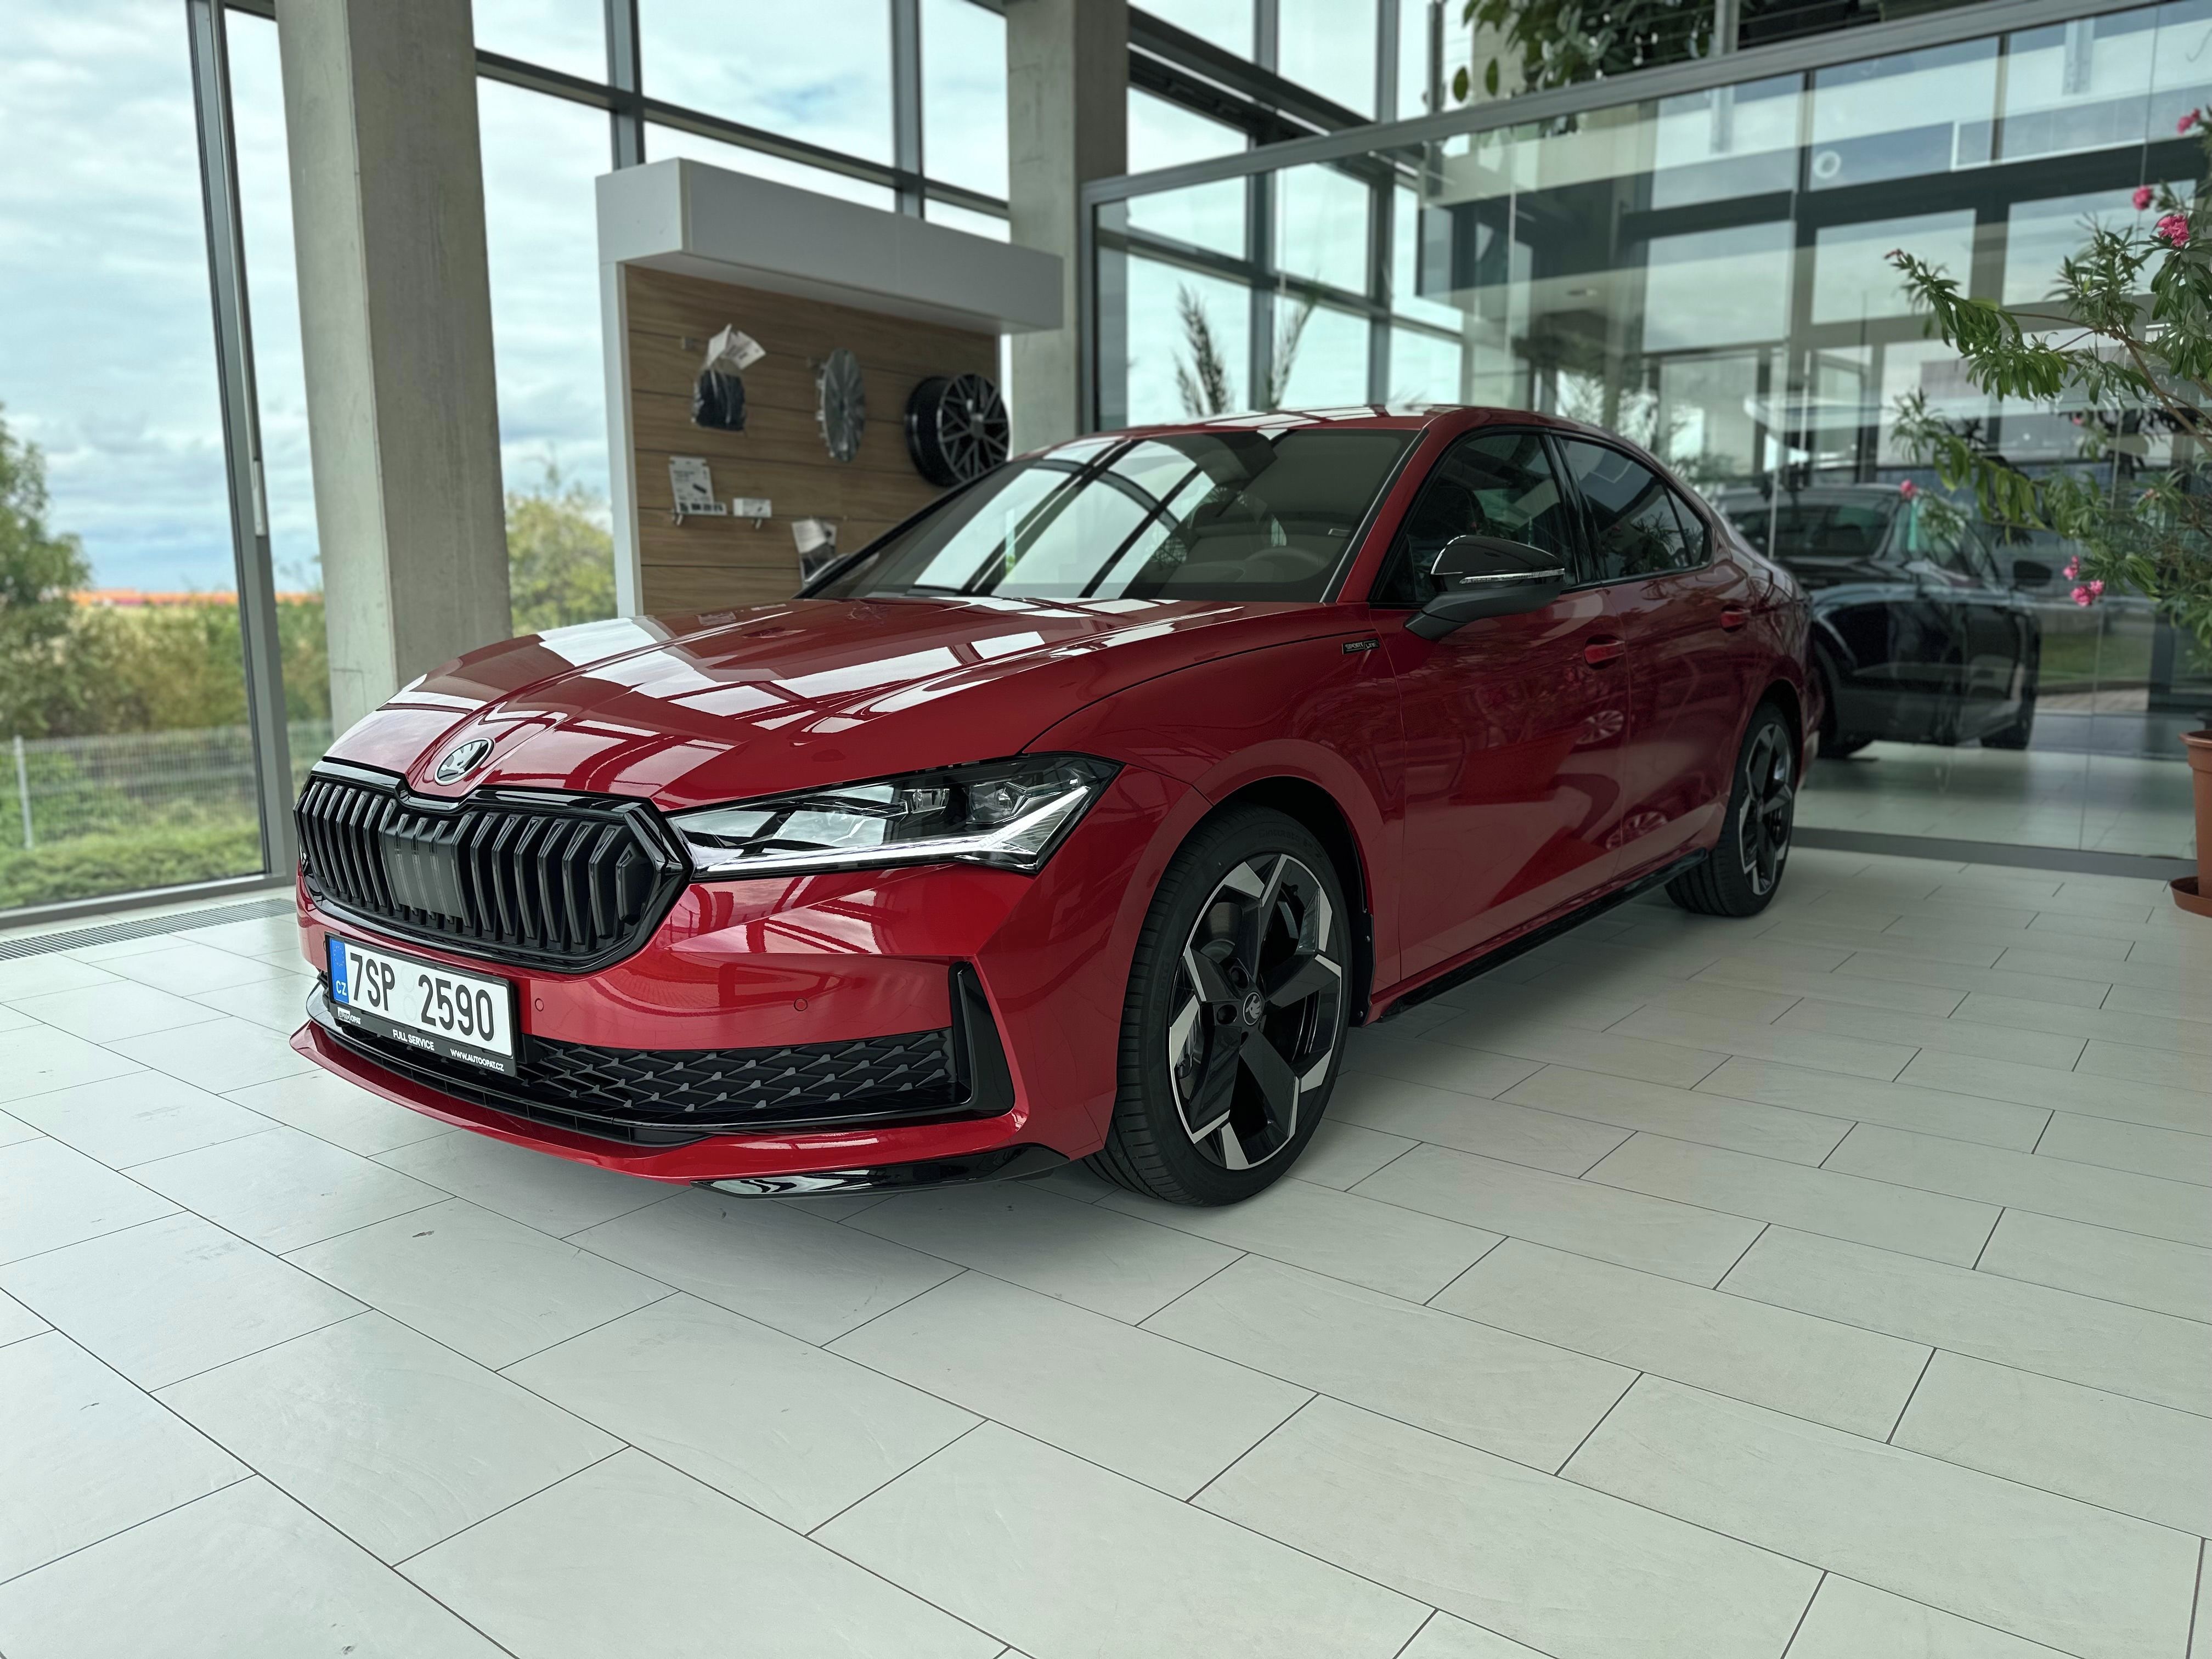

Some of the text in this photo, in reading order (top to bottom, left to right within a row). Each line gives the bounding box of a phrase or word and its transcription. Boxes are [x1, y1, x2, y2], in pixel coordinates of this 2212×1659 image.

[336, 980, 347, 996] CZ
[350, 952, 494, 1041] 7SP 2590
[392, 1029, 435, 1051] FULL SERVICE
[450, 1048, 505, 1072] WWW.AUTOOPAT.CZ
